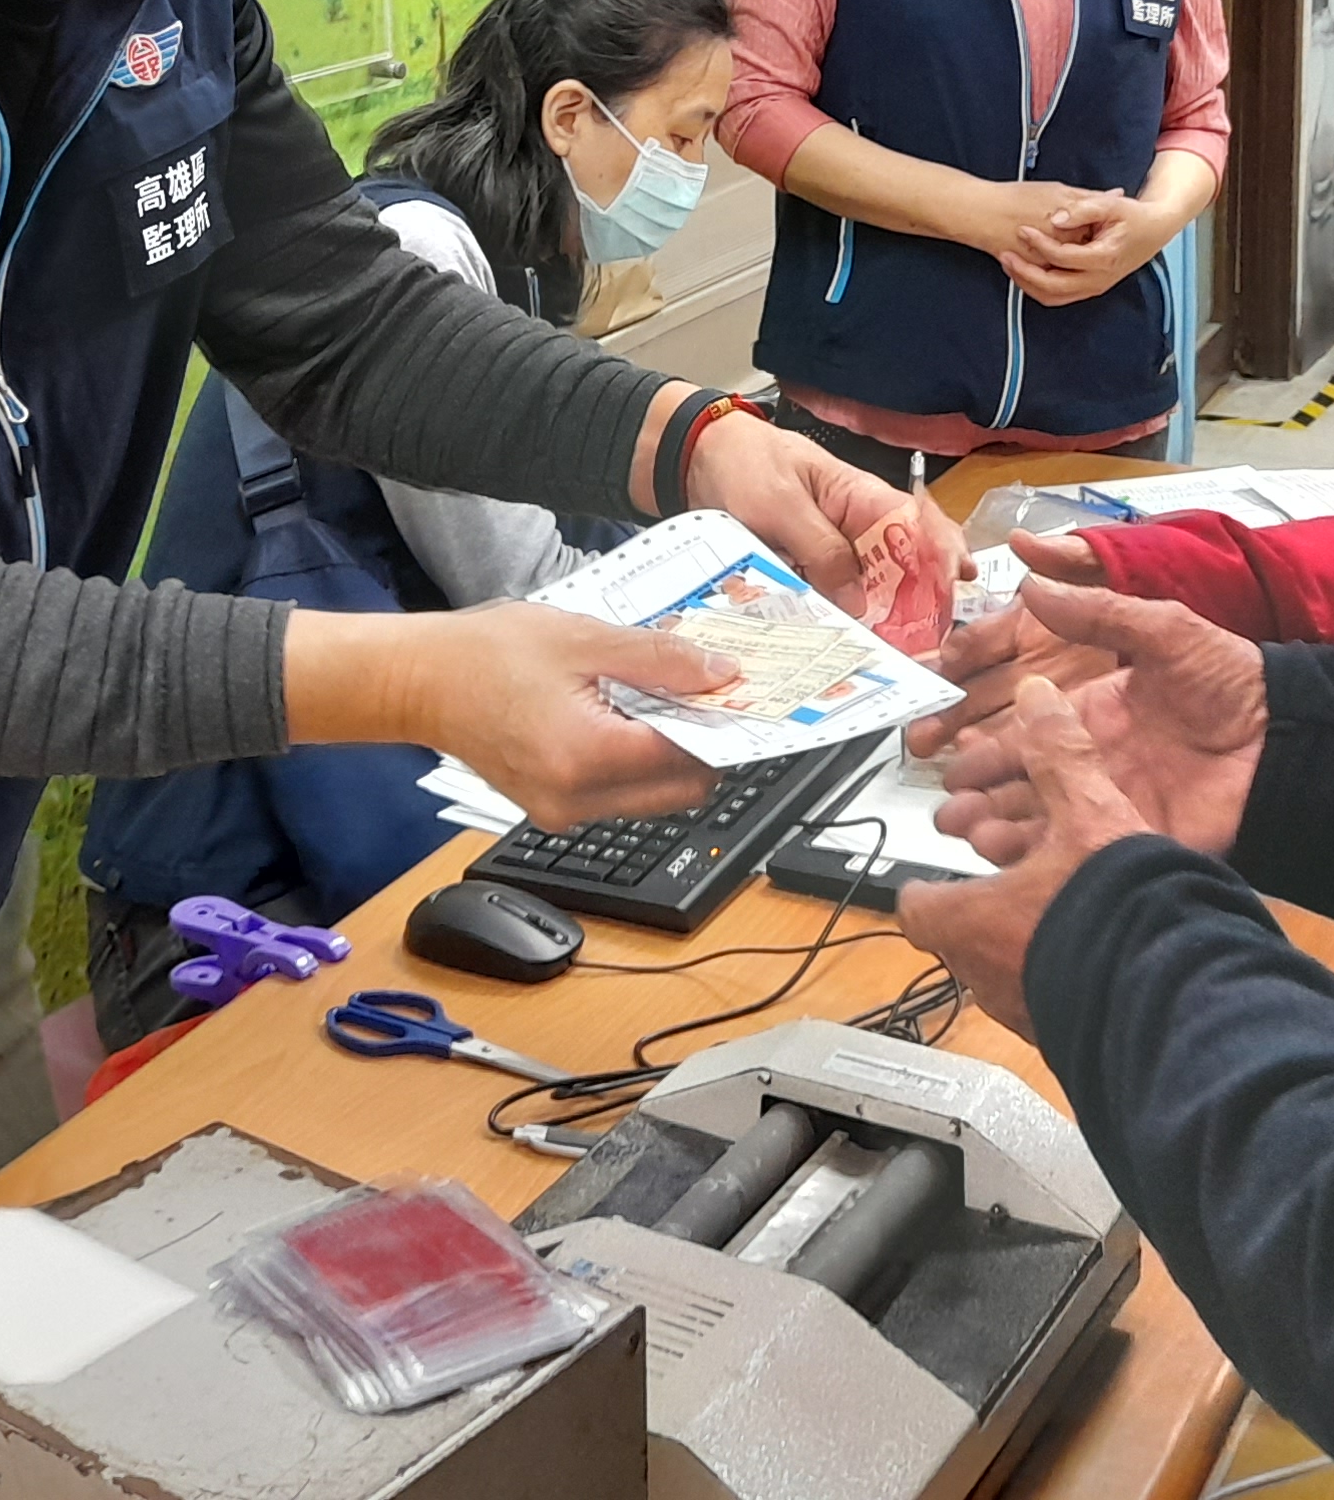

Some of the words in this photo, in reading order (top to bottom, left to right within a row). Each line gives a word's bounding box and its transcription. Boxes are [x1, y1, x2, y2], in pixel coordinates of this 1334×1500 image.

[134, 145, 207, 218] 高雄區
[142, 191, 212, 266] 監理所
